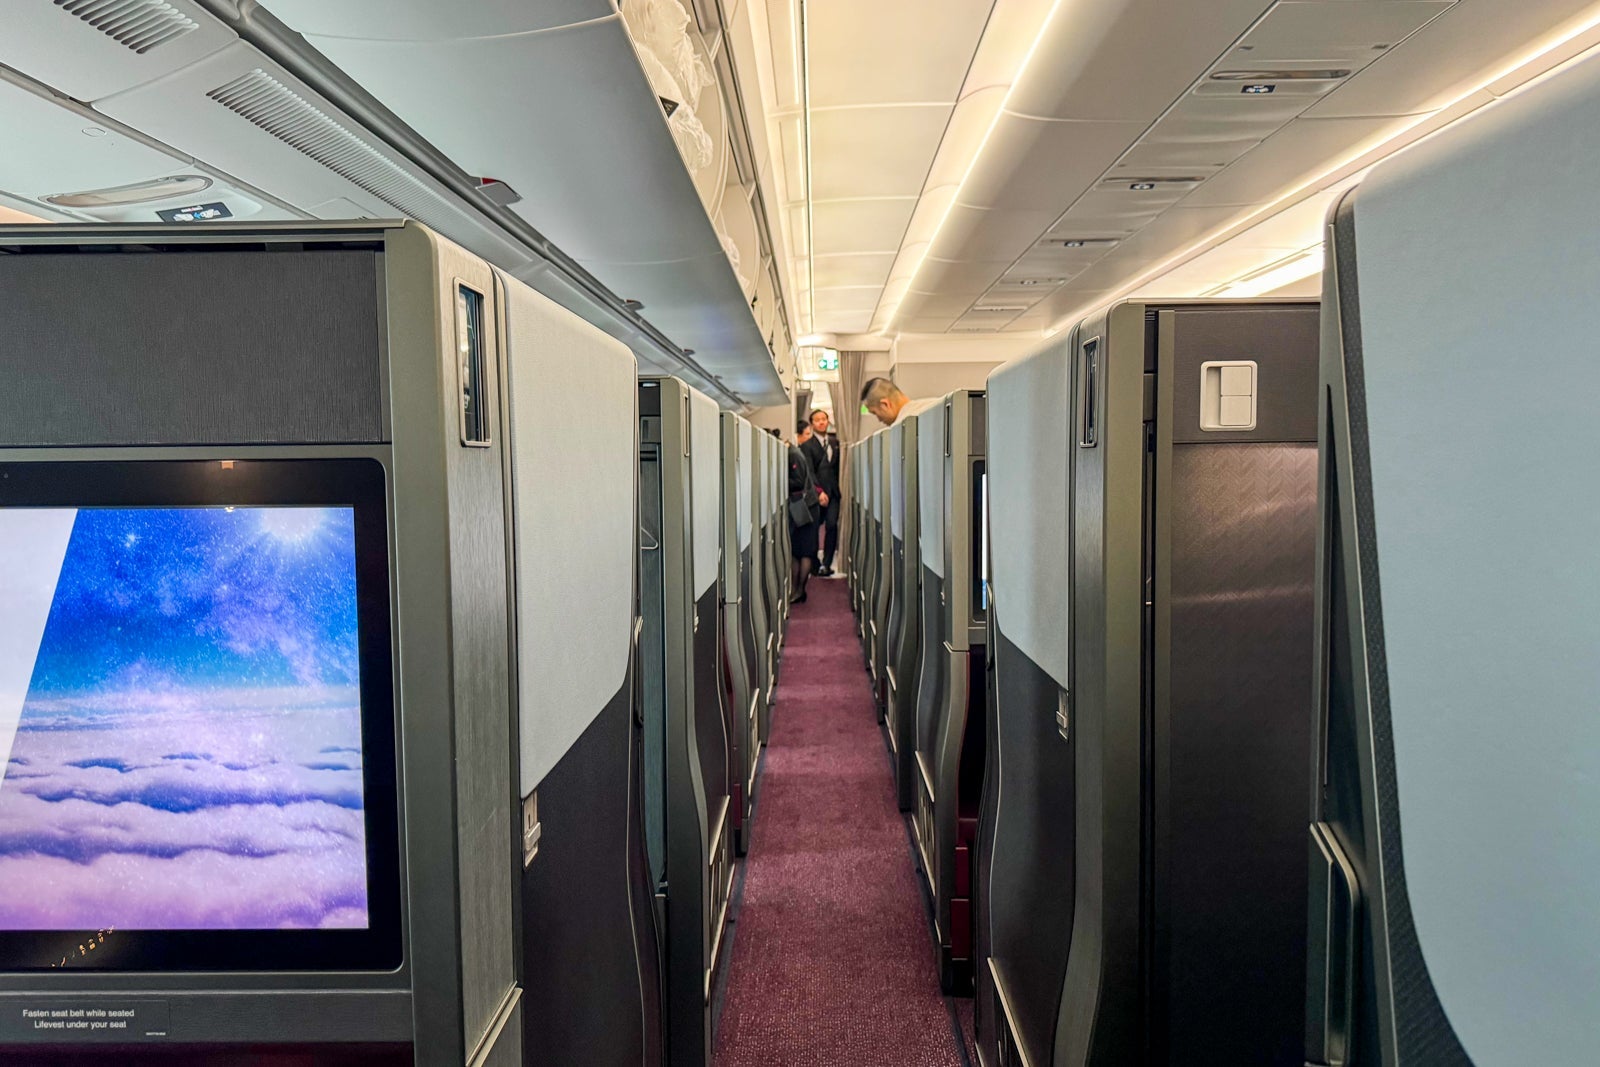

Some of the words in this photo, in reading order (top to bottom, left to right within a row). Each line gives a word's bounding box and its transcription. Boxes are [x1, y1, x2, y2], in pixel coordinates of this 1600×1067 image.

[22, 1009, 50, 1018] Fasten
[51, 1009, 68, 1018] seat
[70, 1009, 84, 1018] belt
[86, 1009, 106, 1018] while
[108, 1009, 135, 1018] seated
[34, 1020, 65, 1029] Lifevest
[66, 1020, 88, 1029] under
[90, 1021, 107, 1030] your
[109, 1020, 127, 1029] seat
